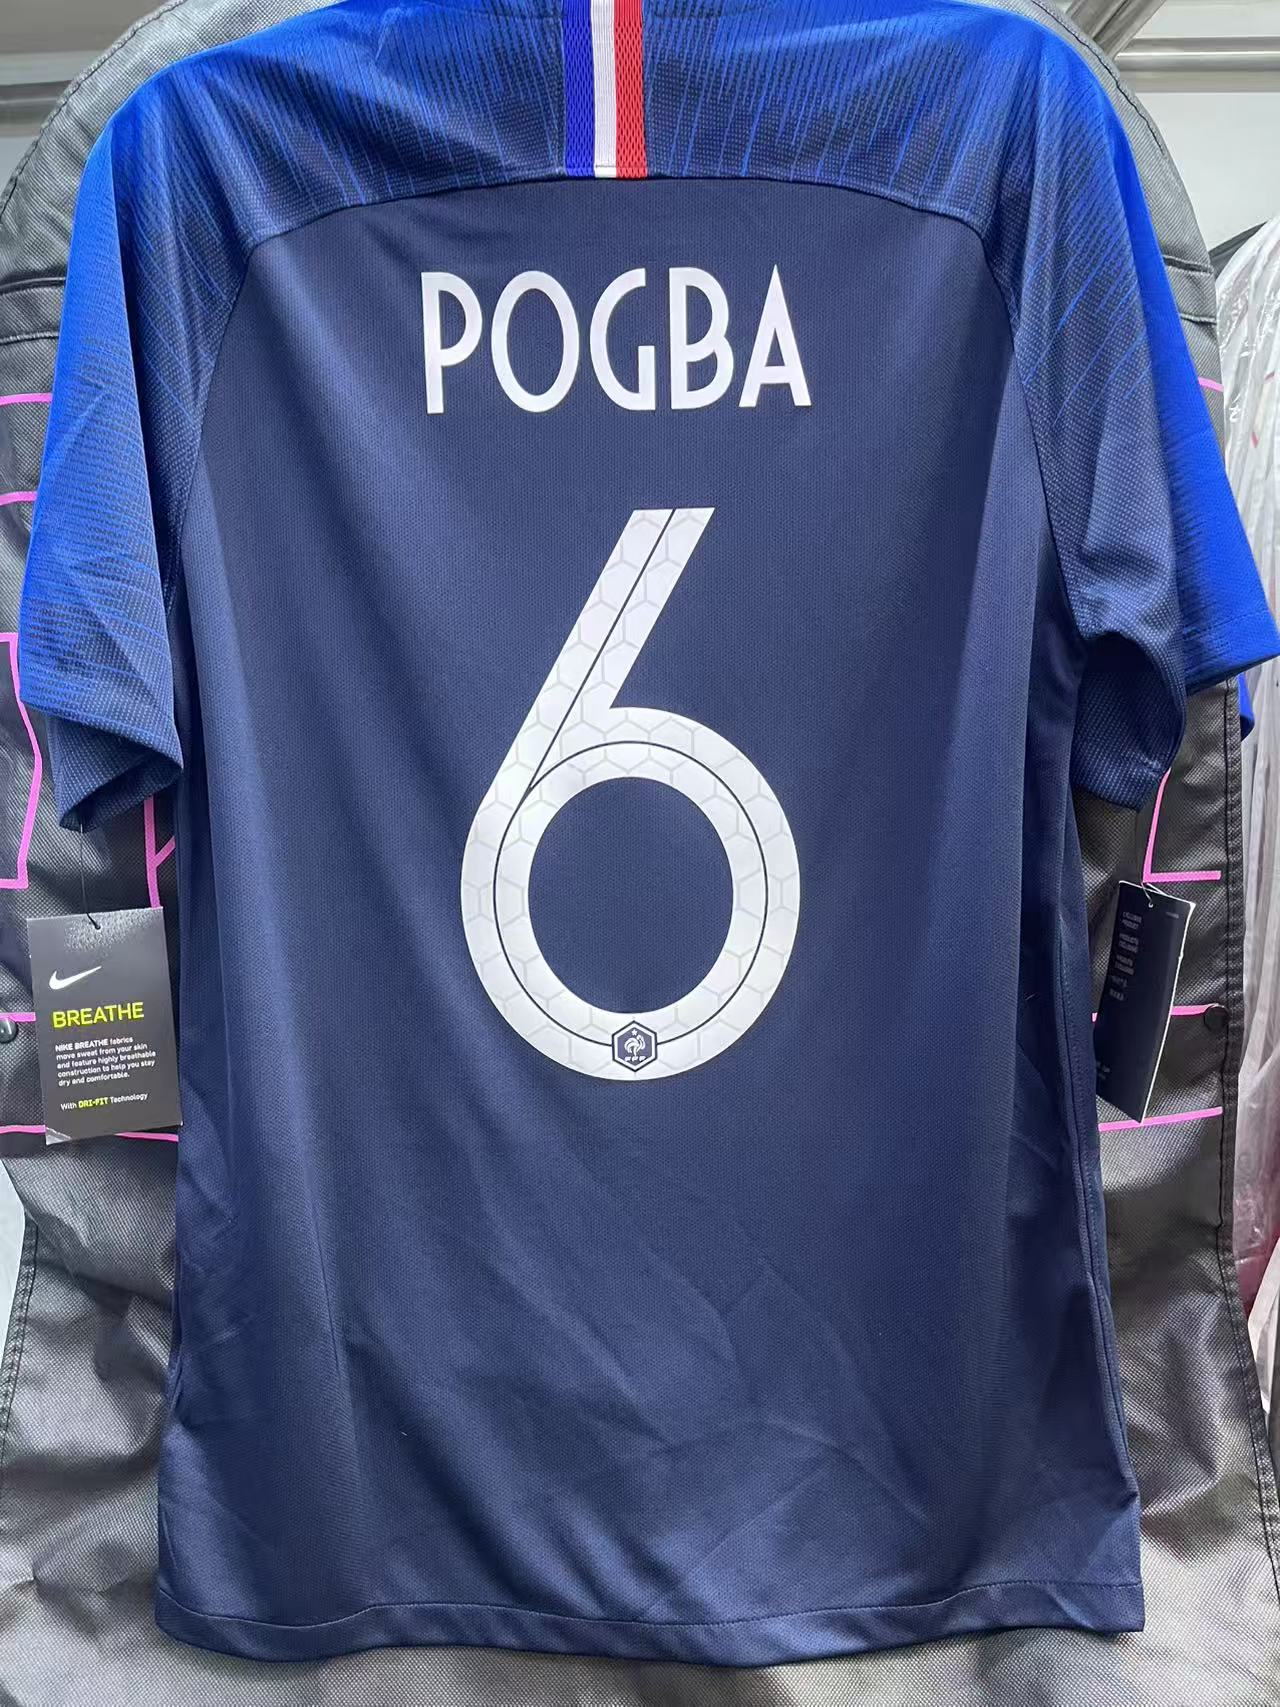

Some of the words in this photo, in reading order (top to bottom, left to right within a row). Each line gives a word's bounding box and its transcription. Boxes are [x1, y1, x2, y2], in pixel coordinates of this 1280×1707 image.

[420, 264, 813, 415] POGBA
[460, 506, 801, 1082] 6
[52, 1001, 145, 1028] BREATHE
[55, 1043, 74, 1052] NIKE
[75, 1039, 109, 1050] BREATHE
[110, 1037, 134, 1046] fabrics
[56, 1053, 76, 1061] move
[77, 1050, 98, 1058] sweat
[99, 1047, 116, 1055] from
[117, 1045, 132, 1054] your
[133, 1043, 148, 1051] skin
[57, 1061, 70, 1069] and
[71, 1058, 97, 1067] feature
[98, 1055, 118, 1065] highly
[120, 1051, 156, 1061] breathable
[57, 1067, 101, 1078] construction
[102, 1064, 110, 1072] to
[111, 1063, 126, 1071] help
[127, 1061, 140, 1069] you
[141, 1059, 155, 1067] stay
[58, 1079, 71, 1087] dry
[72, 1076, 85, 1084] and
[86, 1072, 130, 1083] comfortable.
[60, 1101, 78, 1111] With
[78, 1097, 109, 1109] DRI-FIT
[110, 1093, 148, 1104] Technology
